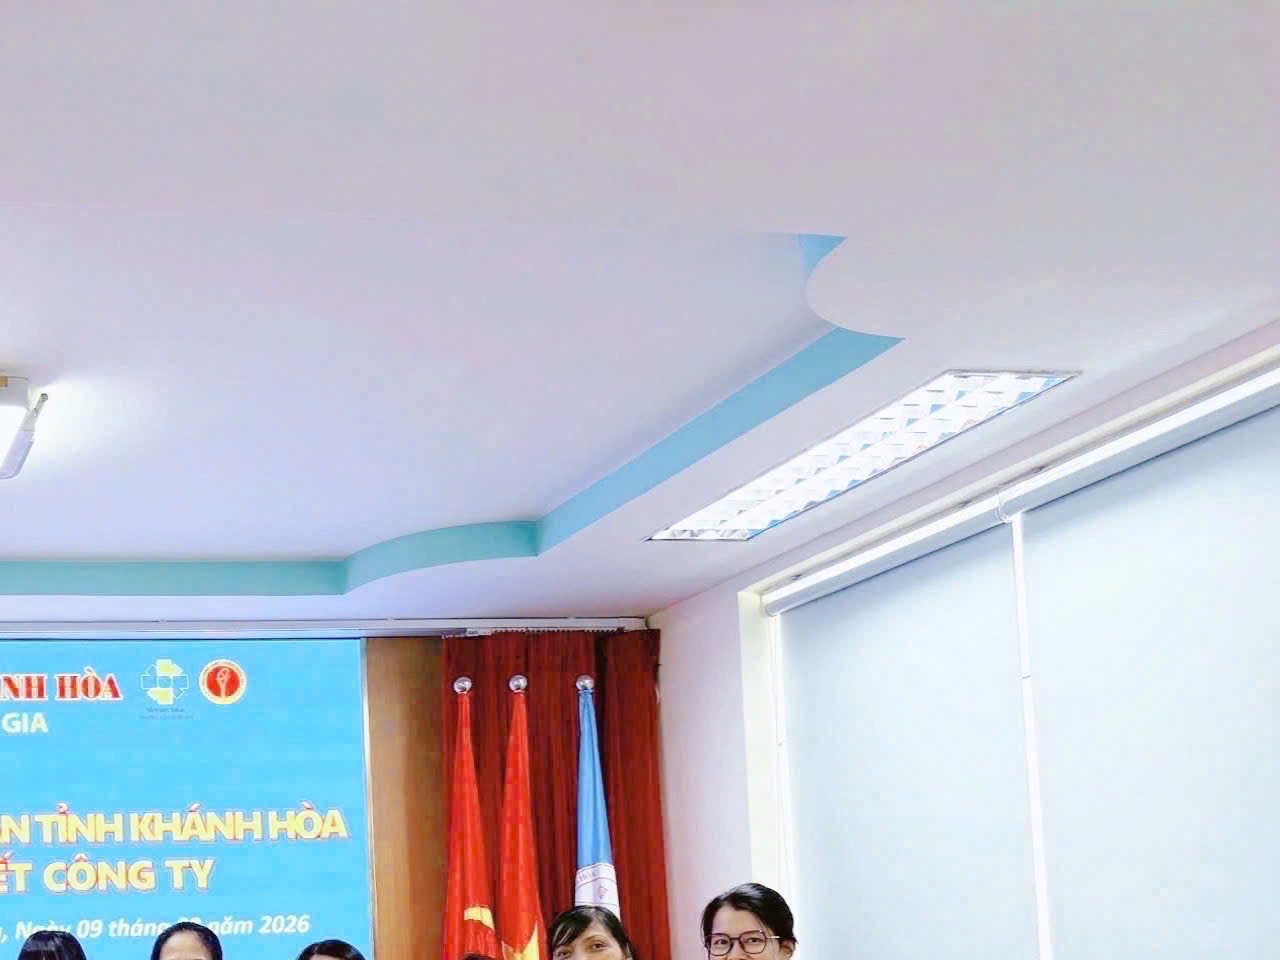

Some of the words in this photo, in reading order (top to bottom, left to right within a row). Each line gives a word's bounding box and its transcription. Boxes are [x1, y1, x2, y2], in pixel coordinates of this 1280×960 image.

[54, 667, 123, 701] HÒA
[1, 712, 49, 735] GIA
[34, 802, 123, 846] TỈNH
[129, 801, 263, 842] KHÁNH
[268, 799, 350, 841] HÒA
[42, 852, 157, 892] CÔNG
[164, 858, 215, 890] TY
[76, 919, 103, 939] 09
[258, 914, 311, 934] 2026
